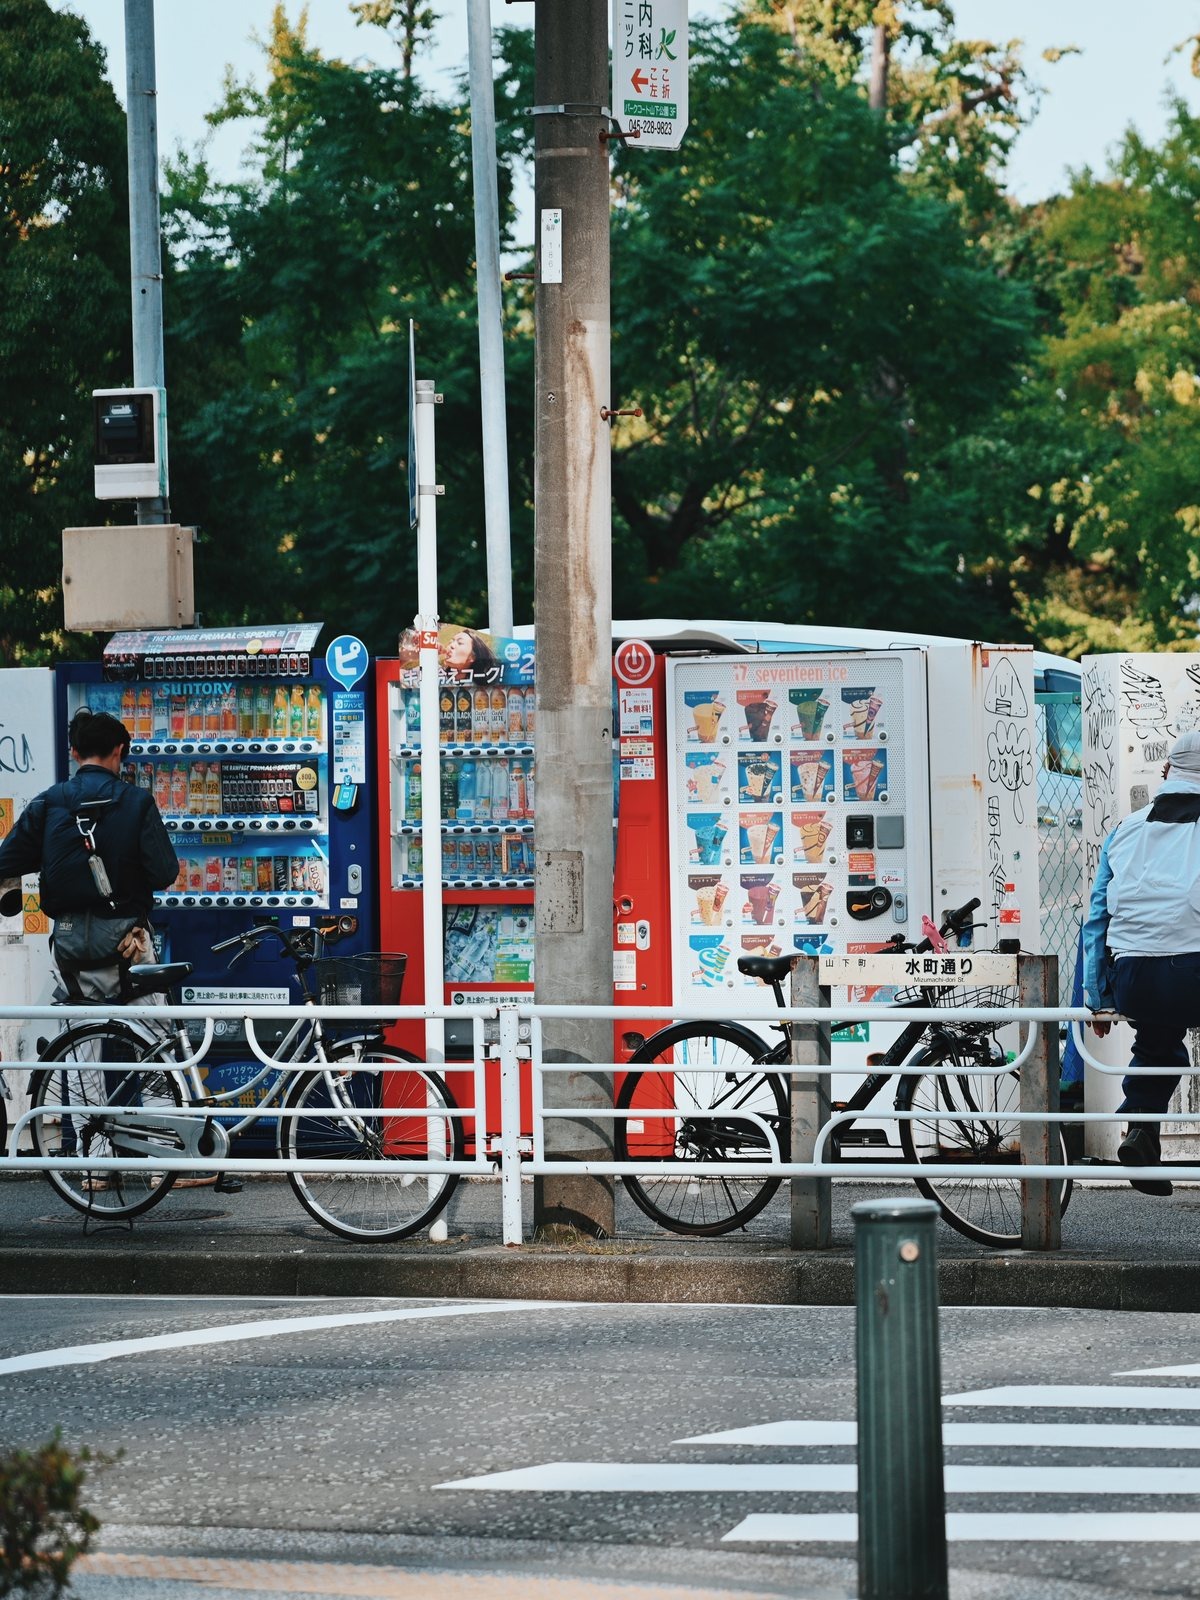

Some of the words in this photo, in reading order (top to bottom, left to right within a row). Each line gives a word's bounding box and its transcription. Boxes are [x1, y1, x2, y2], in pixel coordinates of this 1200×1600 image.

[638, 0, 653, 60] 内科
[649, 83, 671, 99] 左折
[755, 664, 823, 683] seventeen
[828, 661, 848, 681] ice
[825, 958, 867, 968] 山下町
[905, 958, 973, 975] 水町通り
[196, 992, 228, 1000] 売上金の一部は
[466, 996, 498, 1004] 売上金の一部は
